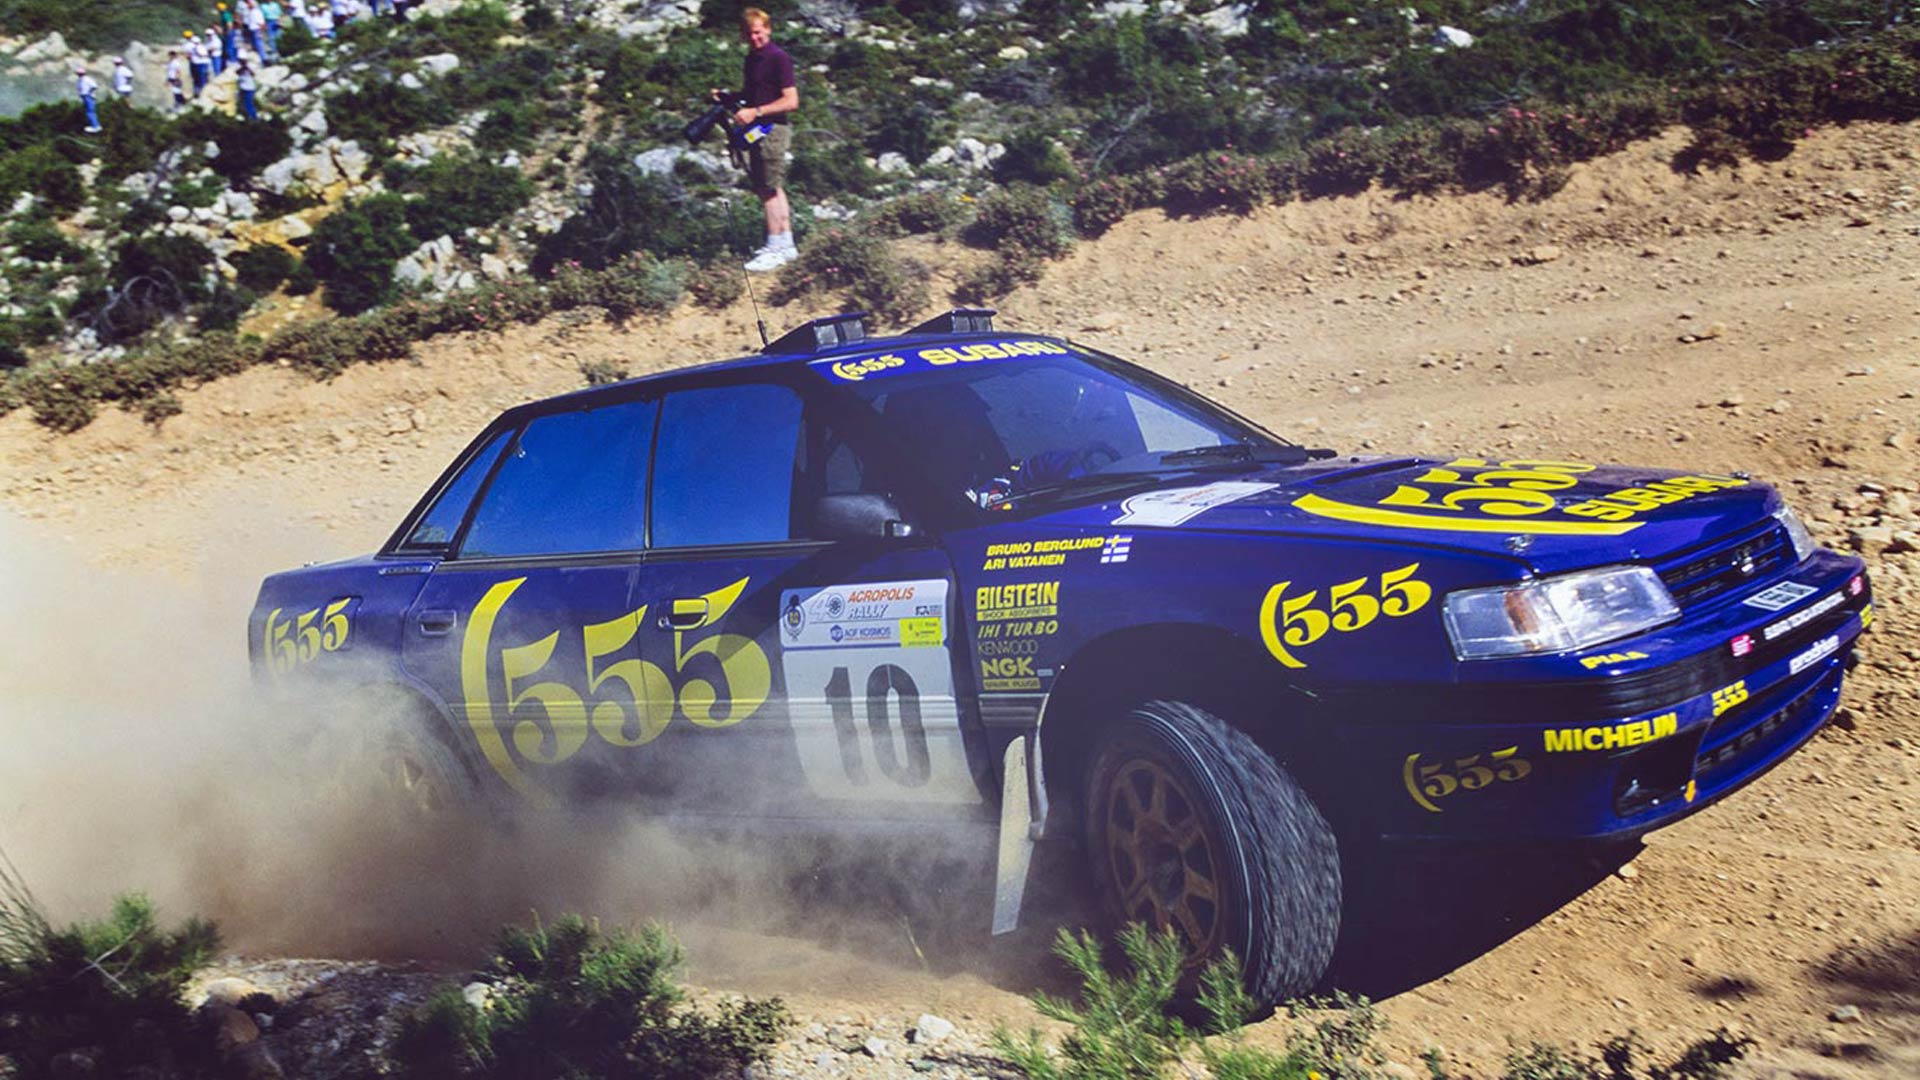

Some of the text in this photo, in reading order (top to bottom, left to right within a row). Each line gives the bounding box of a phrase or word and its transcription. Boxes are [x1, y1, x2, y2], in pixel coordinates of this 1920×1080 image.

[918, 340, 1068, 366] SUBARU
[1562, 473, 1748, 521] SUBARU
[986, 536, 1104, 557] BRUNO BERGLUND
[983, 554, 1066, 571] ARI VATANEN
[848, 587, 915, 603] ACROPOLIS
[976, 581, 1060, 610] BILSTEIN
[848, 604, 889, 620] RALLY
[978, 620, 1059, 639] IHI TURBO
[977, 639, 1038, 656] KENWOOD
[981, 656, 1035, 678] NGK
[1579, 651, 1650, 670] PIAA
[1711, 679, 1749, 717] 555
[824, 664, 931, 788] 10
[1543, 712, 1678, 753] MICHELIN
